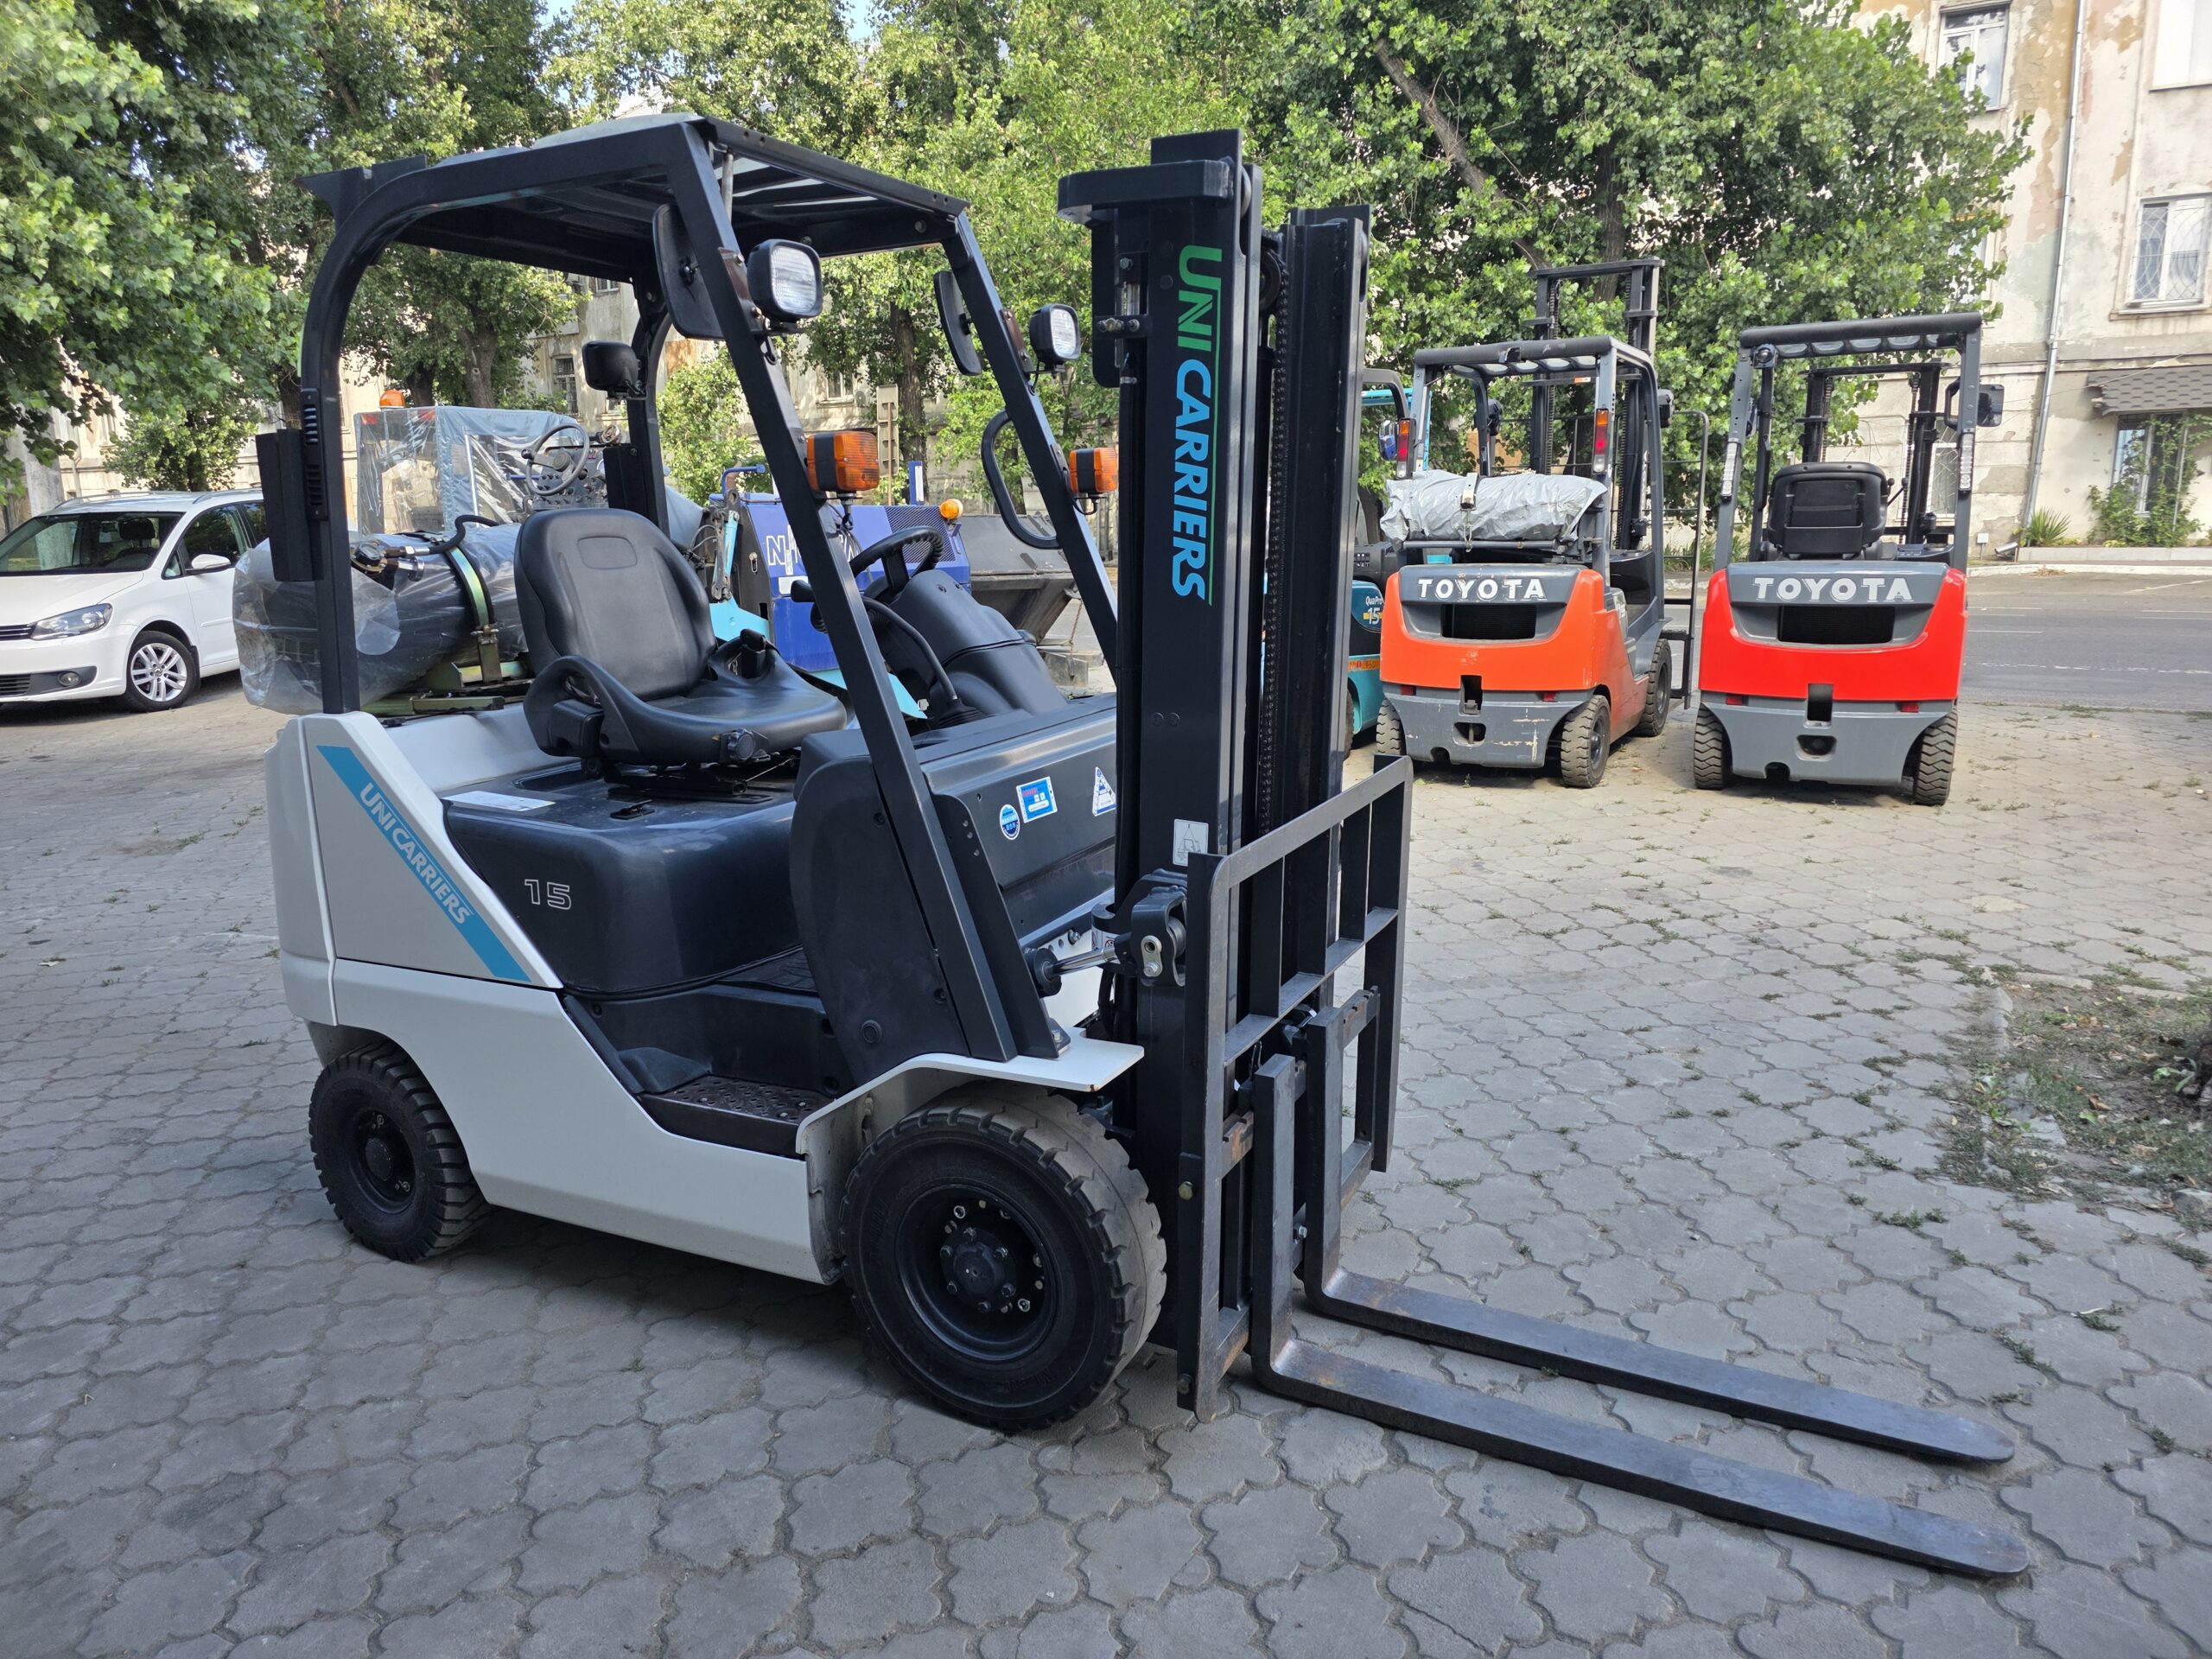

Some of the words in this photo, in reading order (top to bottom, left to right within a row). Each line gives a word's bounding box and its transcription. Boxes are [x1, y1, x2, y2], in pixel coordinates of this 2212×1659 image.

[1418, 578, 1548, 601] TOYOTA
[1752, 577, 1914, 602] TOYOTA
[1367, 607, 1381, 625] 15
[524, 879, 571, 911] 15
